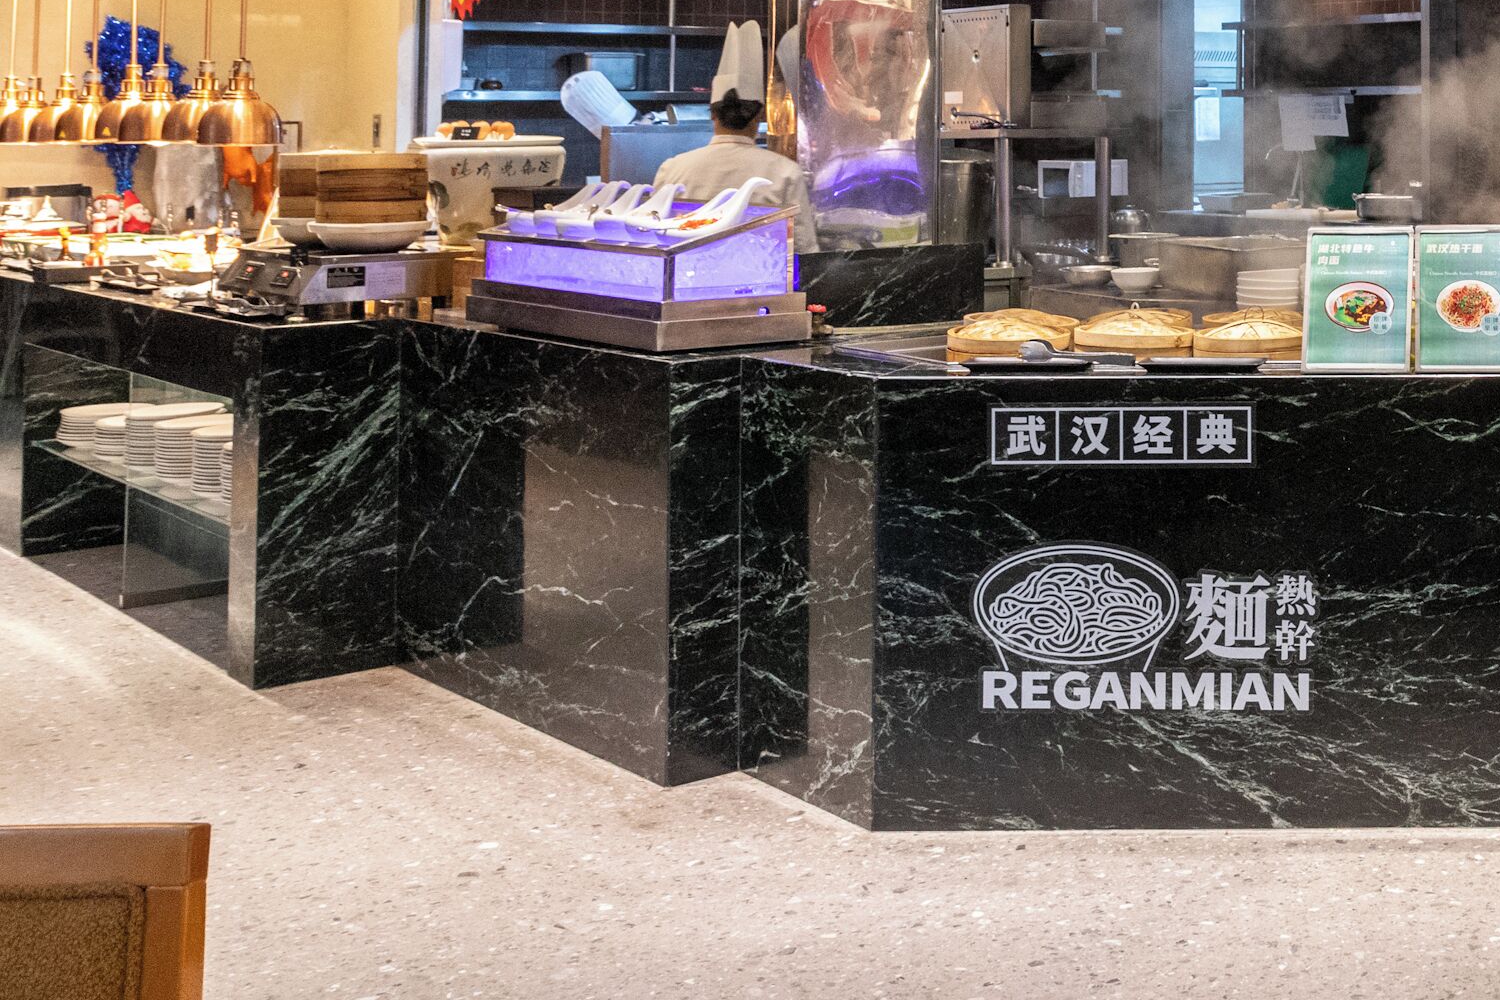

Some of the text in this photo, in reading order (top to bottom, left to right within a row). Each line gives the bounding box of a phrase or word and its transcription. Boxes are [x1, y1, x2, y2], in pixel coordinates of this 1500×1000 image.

[1007, 414, 1236, 456] 武汉经典
[982, 671, 1309, 710] REGANMIAN
